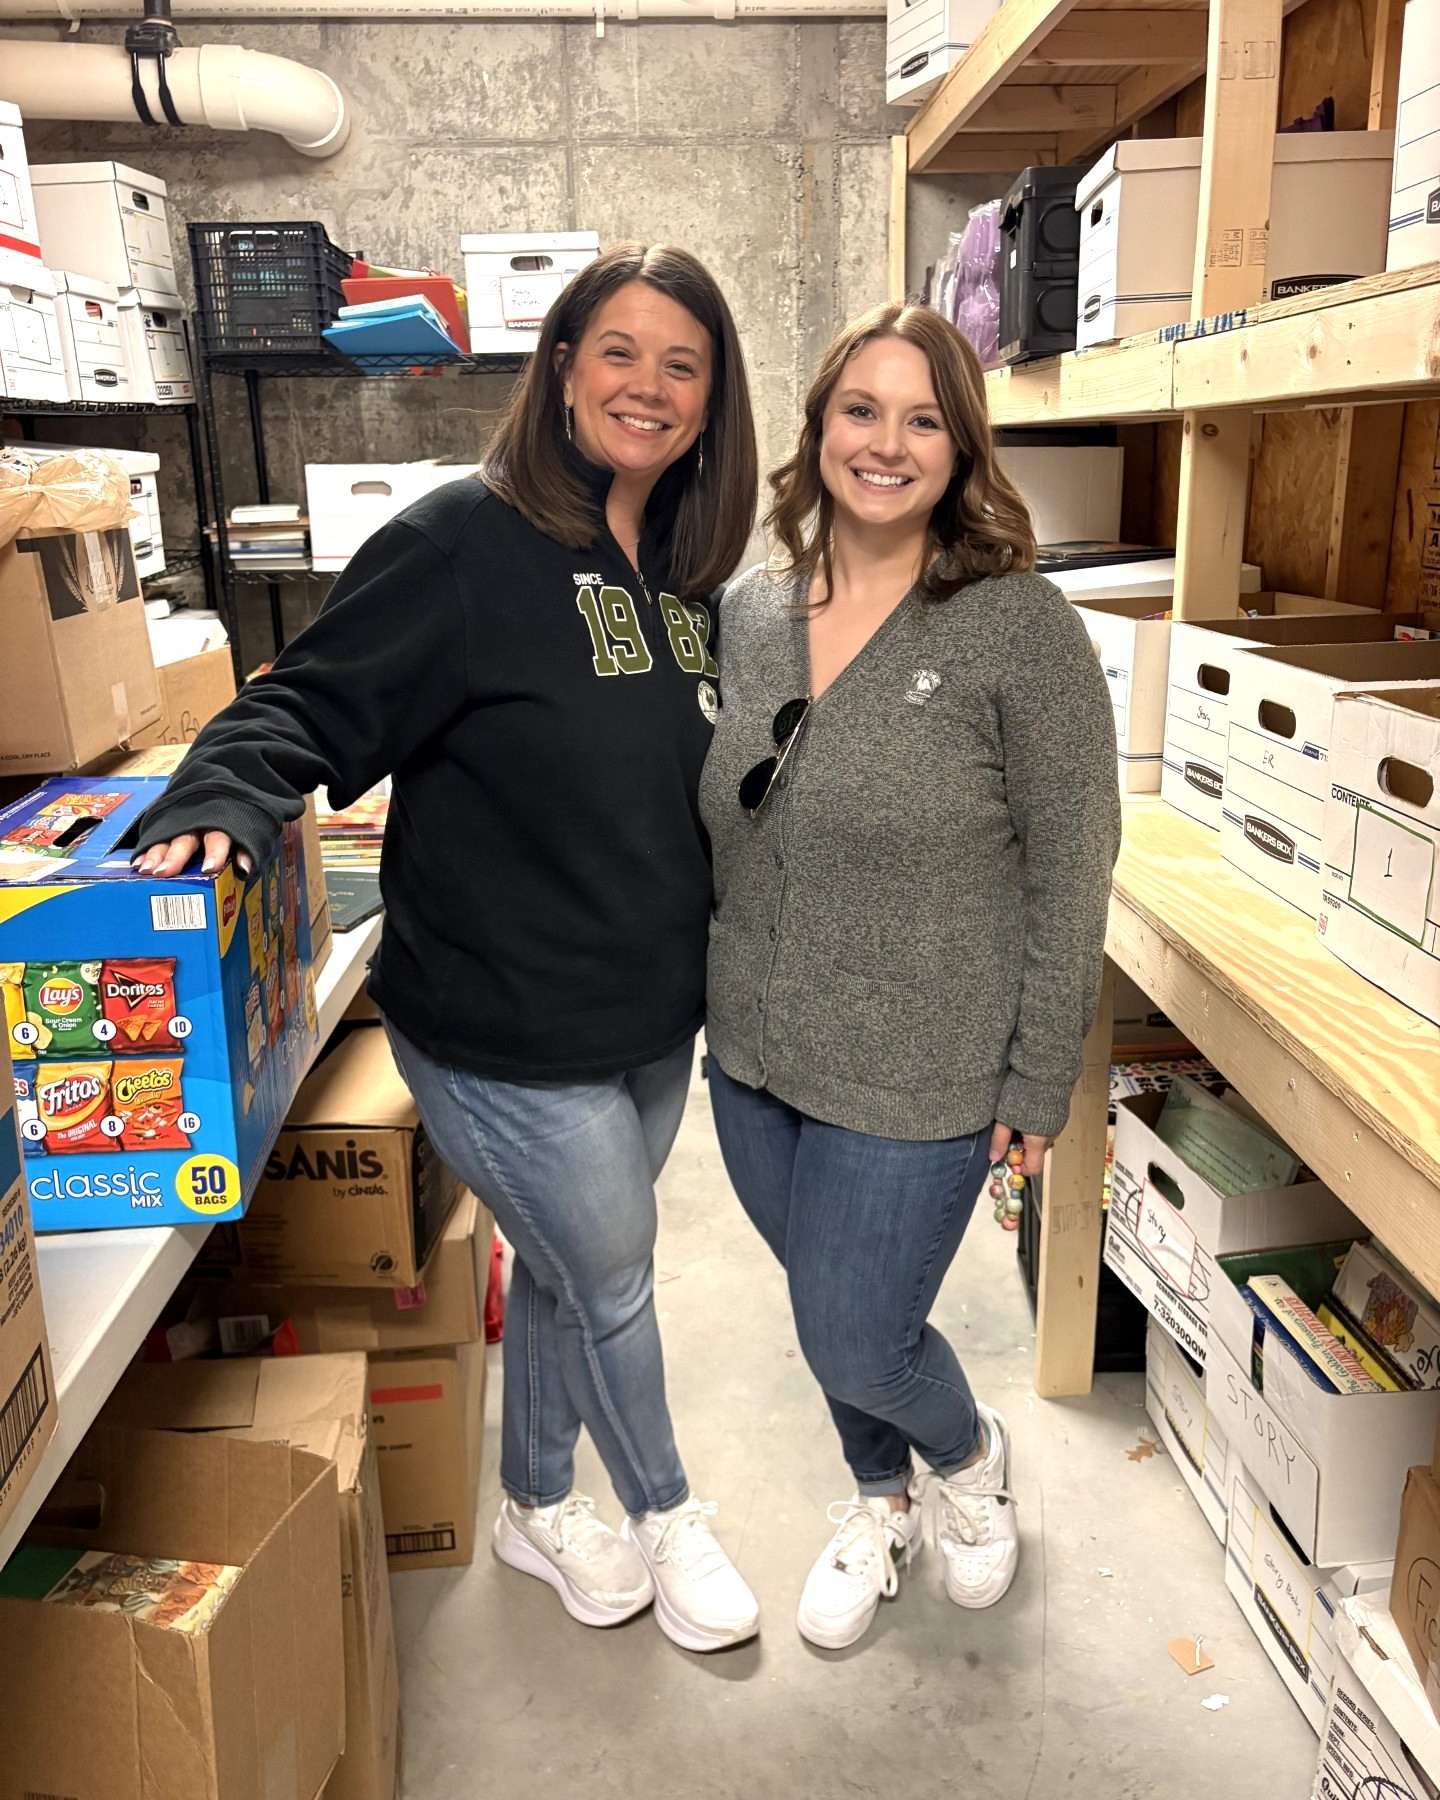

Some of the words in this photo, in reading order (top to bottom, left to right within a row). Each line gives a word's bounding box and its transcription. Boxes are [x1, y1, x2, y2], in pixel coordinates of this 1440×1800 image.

[1278, 284, 1331, 295] BANKE
[573, 573, 604, 585] SINCE
[1186, 767, 1213, 787] BANKERS
[1213, 782, 1223, 791] BO
[1246, 822, 1277, 846] BANKERS
[1276, 839, 1292, 856] BOX
[43, 985, 81, 1007] Lay's
[106, 983, 164, 998] Doritos
[22, 1028, 29, 1039] 6
[100, 1024, 108, 1035] 4
[175, 1021, 187, 1033] 10
[40, 1077, 101, 1117] Fritos
[117, 1070, 173, 1102] Cheetos
[31, 1124, 38, 1136] 6
[57, 1131, 67, 1139] The
[67, 1119, 97, 1138] ORIGINAL
[108, 1120, 116, 1132] 8
[184, 1117, 195, 1130] 16
[30, 1166, 162, 1201] classic
[191, 1165, 226, 1196] 50
[131, 1193, 164, 1208] MIX
[195, 1195, 228, 1206] BAGS
[332, 1187, 346, 1199] by
[1147, 1208, 1167, 1243] Story
[1152, 1300, 1207, 1363] 7-32030QQW
[1294, 1316, 1323, 1351] Treasury
[1321, 1349, 1350, 1378] Golden
[1226, 1374, 1296, 1484] STORY
[1336, 1687, 1357, 1711] RECORD
[1333, 1703, 1358, 1733] CONTENTS:
